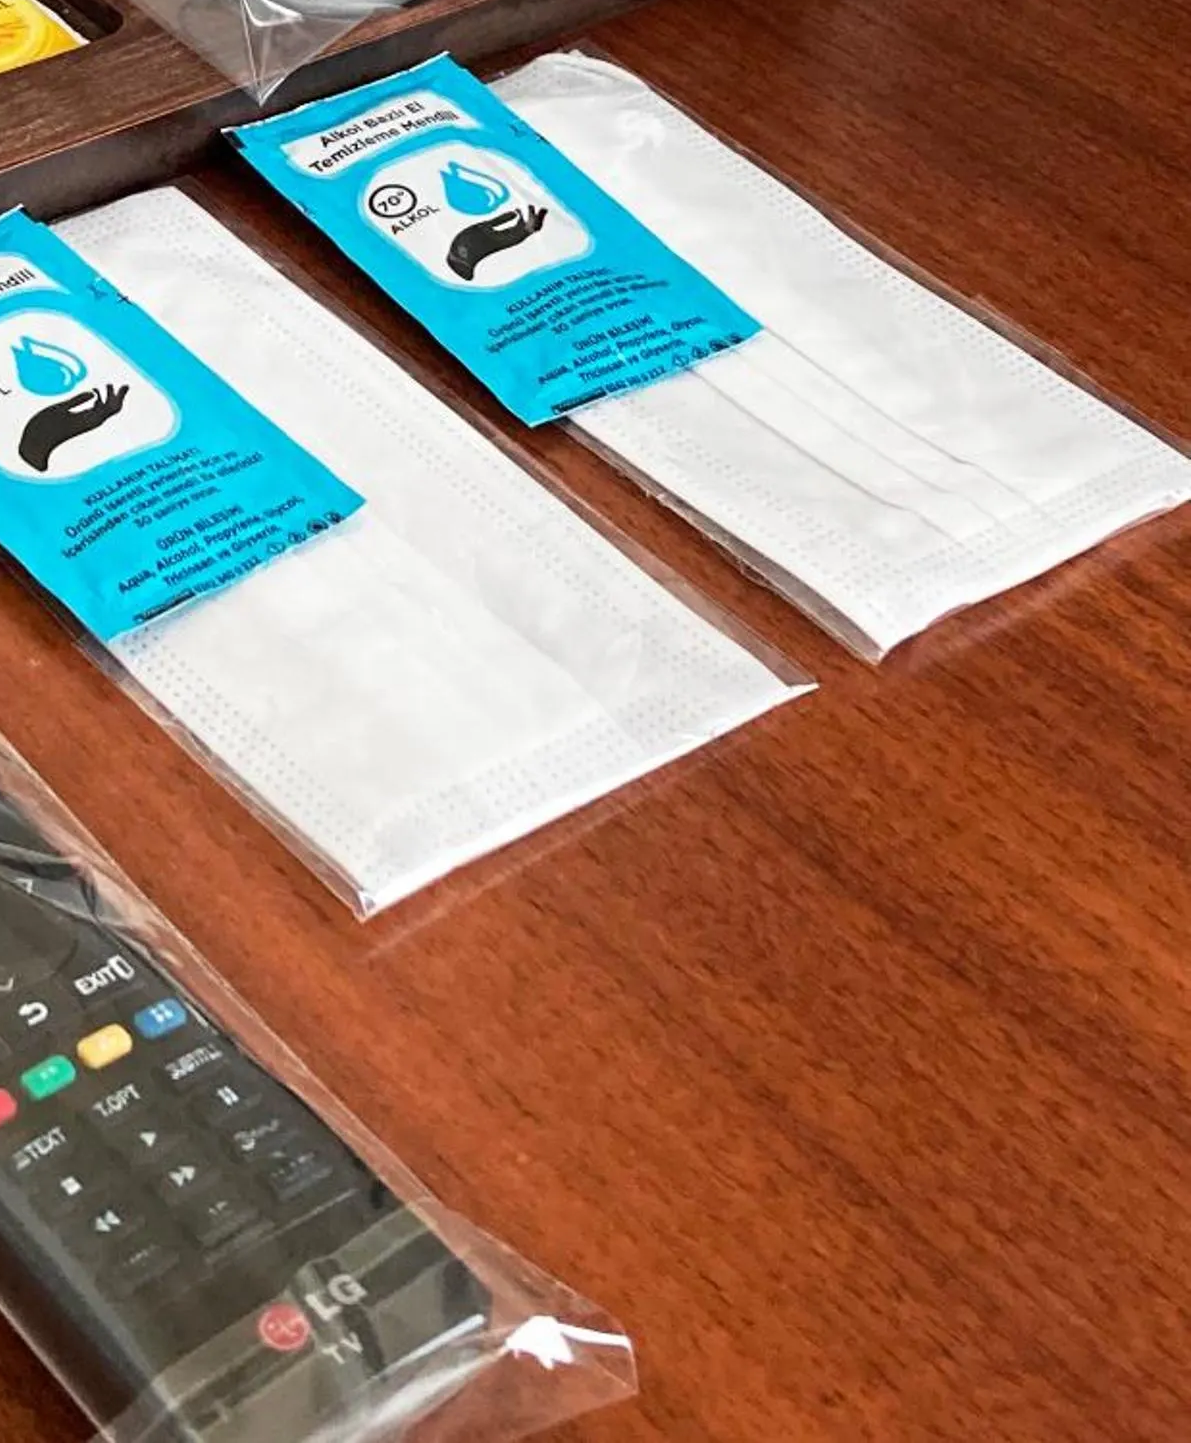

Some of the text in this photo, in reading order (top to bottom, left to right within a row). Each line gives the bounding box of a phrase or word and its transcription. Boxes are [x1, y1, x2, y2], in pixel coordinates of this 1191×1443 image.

[309, 128, 401, 173] Temizleme
[319, 123, 364, 148] Alkol
[388, 204, 441, 235] ALKOL
[73, 960, 118, 997] EXIT
[24, 1126, 68, 1163] TEXT
[304, 1272, 369, 1322] LG
[321, 1330, 364, 1366] TV
